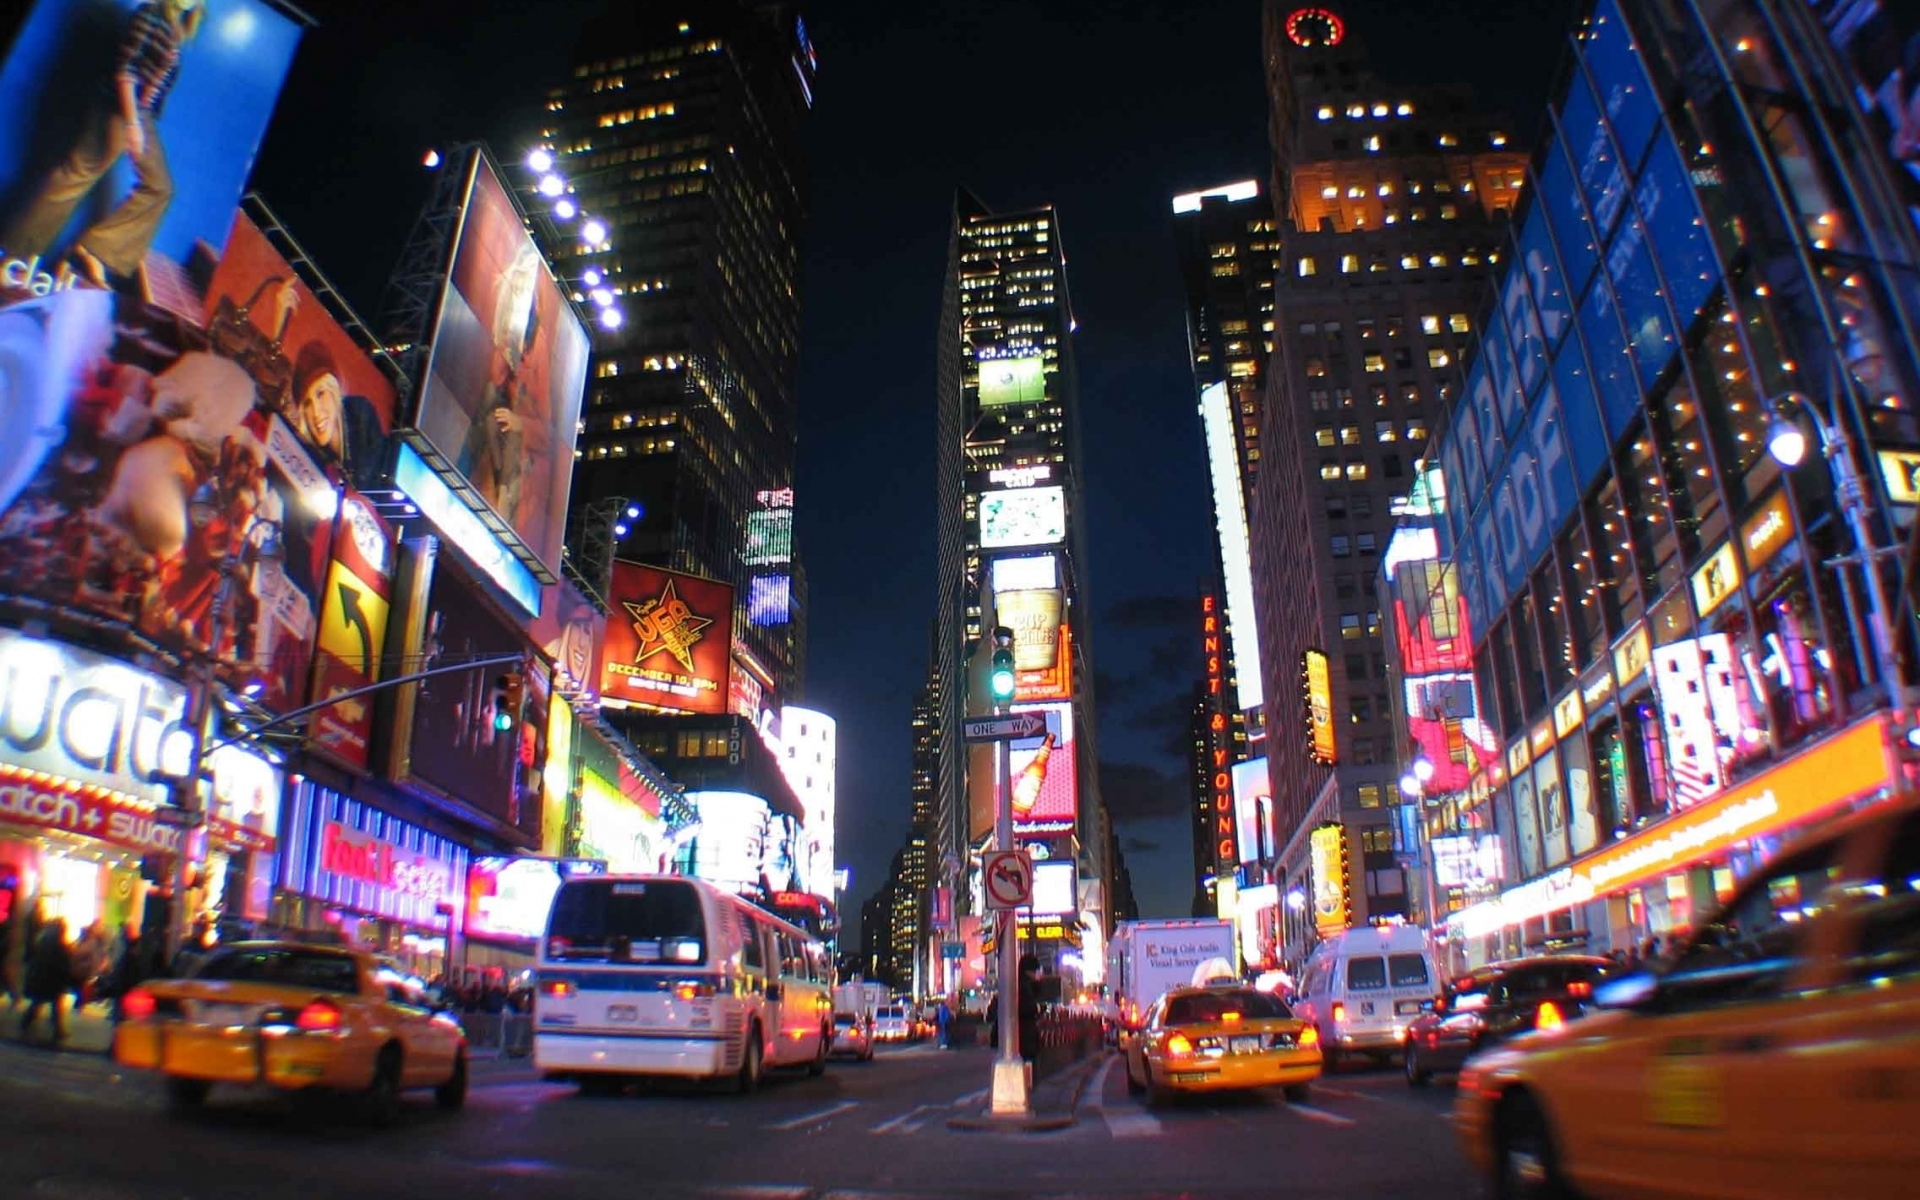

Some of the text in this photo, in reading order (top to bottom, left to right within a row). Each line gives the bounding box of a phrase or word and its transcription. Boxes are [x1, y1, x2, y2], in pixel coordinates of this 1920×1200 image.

[1202, 596, 1222, 695] ERNST
[972, 719, 1035, 735] ONE WAY
[1212, 748, 1235, 859] YOUNG
